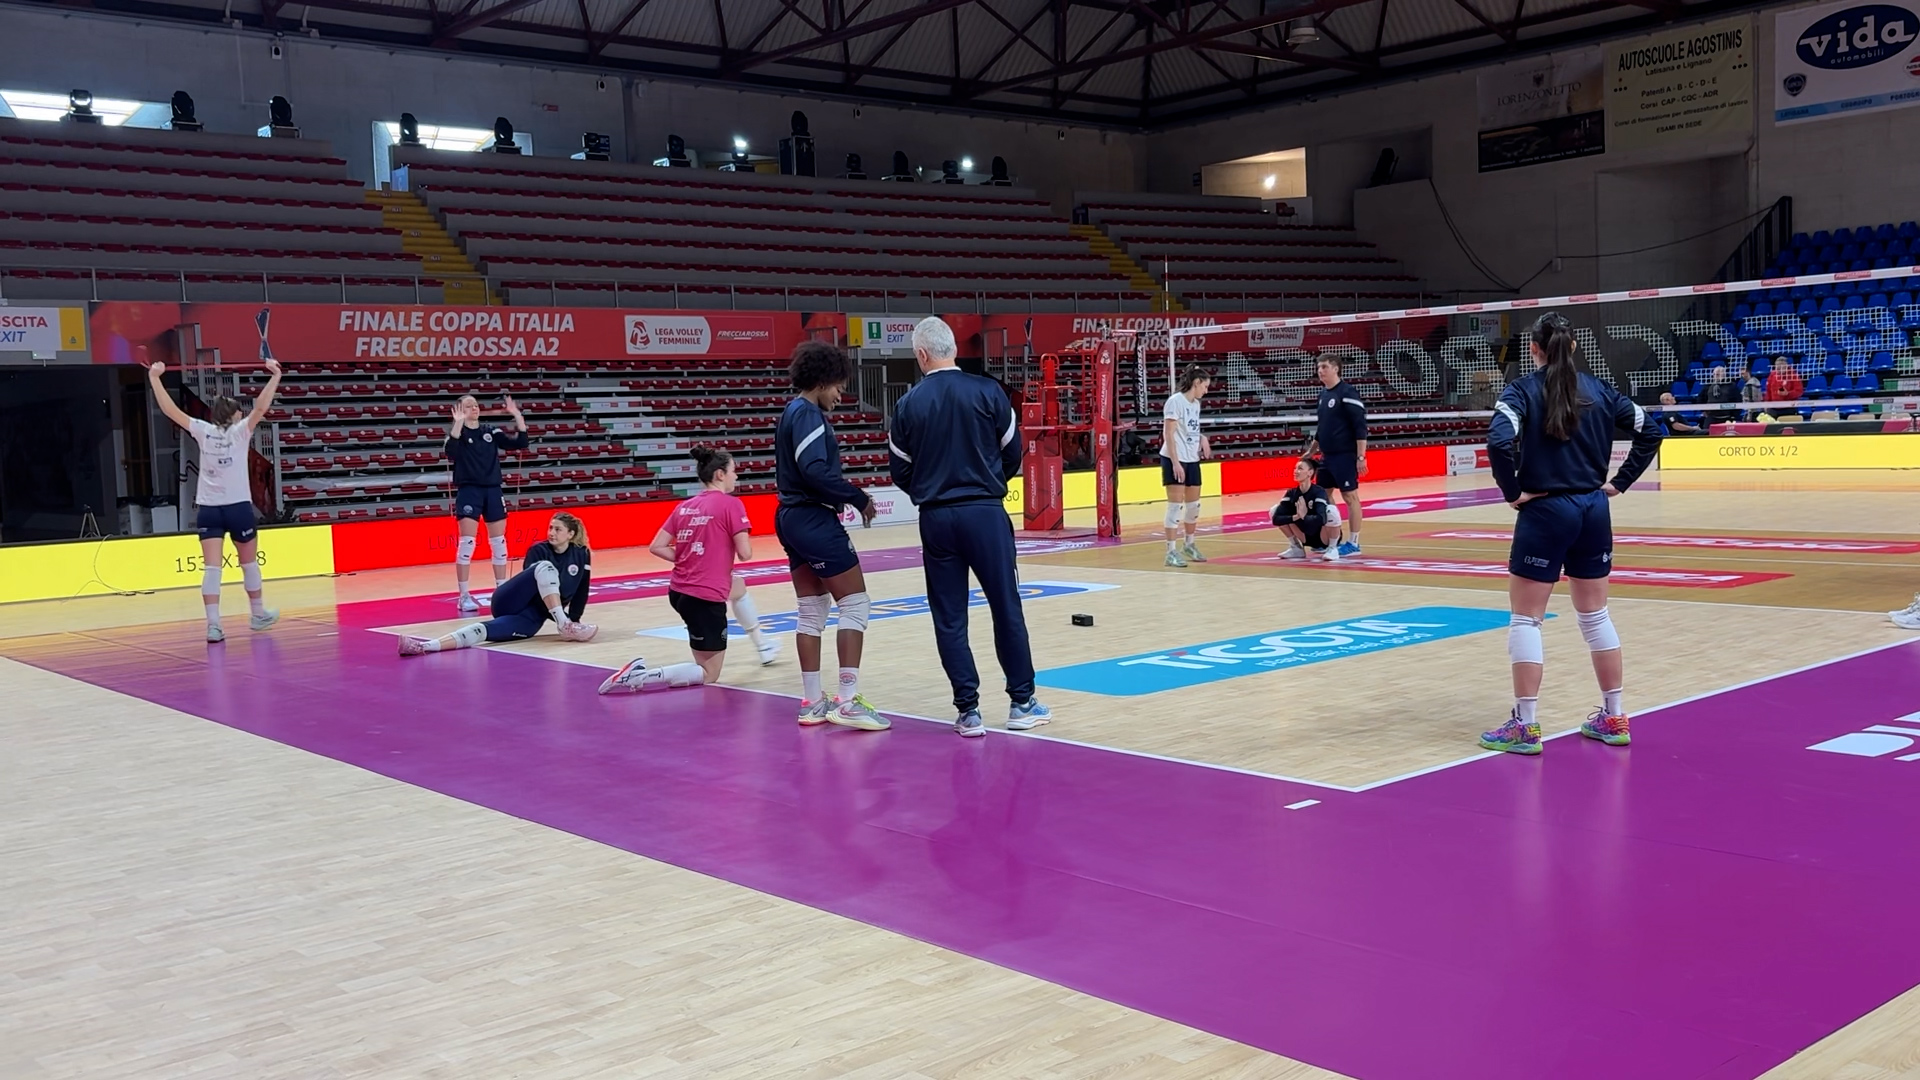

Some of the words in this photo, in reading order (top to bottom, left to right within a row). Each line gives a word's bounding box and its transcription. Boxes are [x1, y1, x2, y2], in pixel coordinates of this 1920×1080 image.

[1799, 15, 1916, 57] vida
[1618, 40, 1685, 72] AUTOSCUOLE
[1687, 29, 1742, 58] AGOSTINIS
[1831, 48, 1884, 64] automobili
[1645, 65, 1675, 76] Latisana
[1683, 57, 1712, 69] Lignano
[1641, 86, 1665, 97] Patenti
[1641, 102, 1658, 110] Corsi
[1661, 97, 1676, 106] CAP
[1681, 94, 1697, 103] CQC
[1703, 90, 1718, 98] ADR
[1638, 113, 1670, 123] formazione
[1672, 111, 1681, 119] per
[1728, 99, 1748, 107] lavoro
[1656, 125, 1676, 133] ESAMI
[1685, 120, 1702, 128] SEDE
[0, 316, 48, 328] SCITA
[339, 311, 424, 332] FINALE
[429, 312, 503, 332] COPPA
[508, 313, 574, 333] ITALIA
[886, 324, 914, 333] USCITA
[0, 331, 26, 342] XIT
[654, 328, 673, 336] LEGA
[676, 328, 703, 336] VOLLEY
[717, 330, 769, 338] FRECCIAROSSA
[887, 335, 904, 343] EXIT
[355, 337, 527, 357] FRECCIAROSSA
[531, 337, 560, 356] A2
[658, 337, 701, 345] FEMMINILE
[1188, 336, 1207, 351] A2
[1719, 446, 1755, 457] CORTO
[1760, 446, 1775, 456] DX
[1780, 446, 1798, 456] 1/2
[515, 528, 539, 543] 2/2
